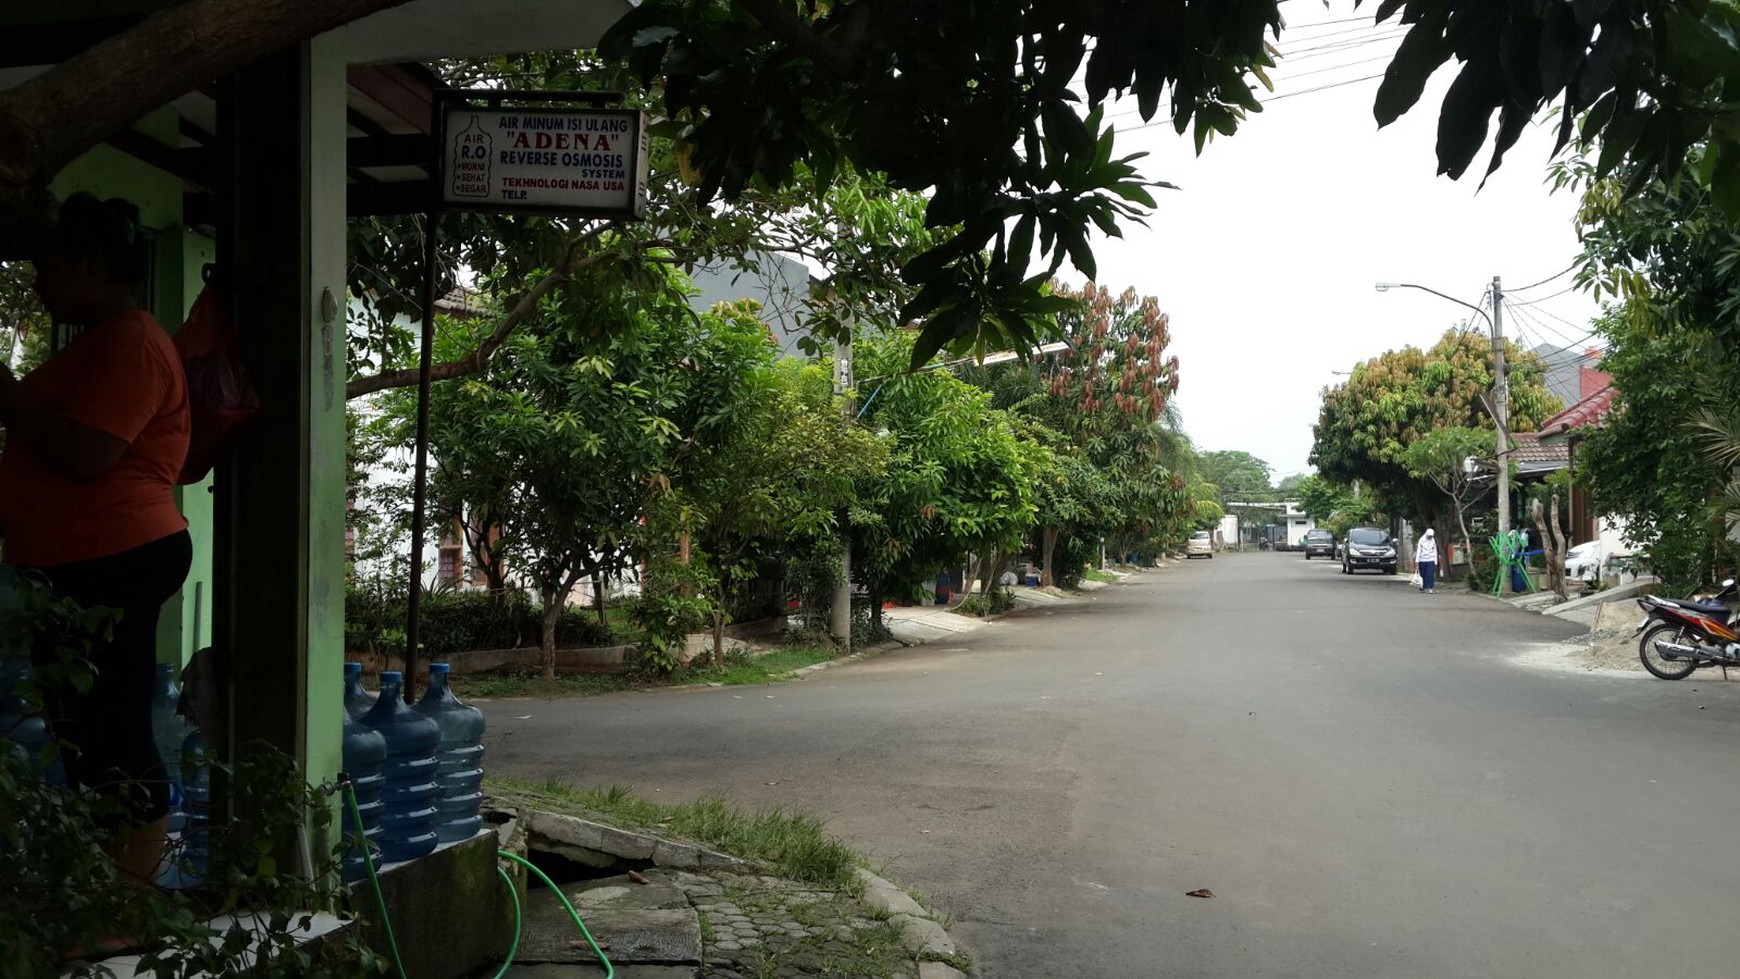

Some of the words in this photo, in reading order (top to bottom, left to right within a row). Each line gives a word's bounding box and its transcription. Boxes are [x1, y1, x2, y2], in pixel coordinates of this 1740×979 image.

[499, 116, 519, 129] AIR
[522, 117, 564, 130] MINUM
[567, 118, 582, 130] ISI
[585, 119, 628, 132] ULANG
[464, 134, 484, 144] AIR
[507, 130, 619, 151] "ADENA"
[462, 145, 486, 159] R.O
[500, 150, 557, 166] REVERSE
[561, 153, 623, 168] OSMOSIS
[461, 173, 486, 182] SEHAT
[581, 168, 625, 179] SYSTEM
[460, 184, 486, 193] SEGAR
[502, 177, 568, 189] TEKHNOLOGI
[571, 180, 600, 190] NASA
[603, 181, 625, 191] USA
